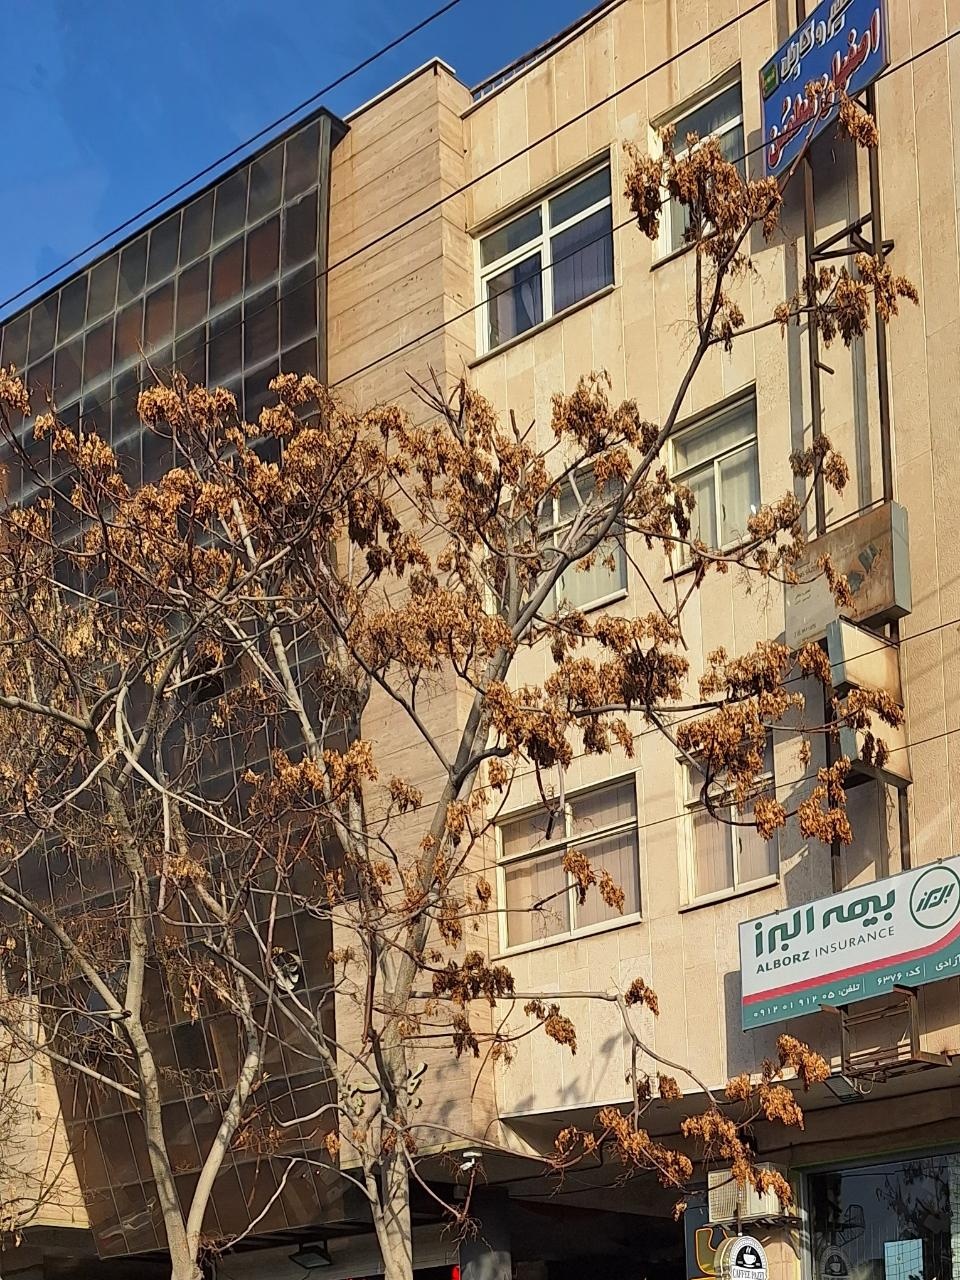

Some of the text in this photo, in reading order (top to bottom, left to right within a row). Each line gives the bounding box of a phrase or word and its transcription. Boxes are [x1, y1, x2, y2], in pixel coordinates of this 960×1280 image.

[754, 888, 896, 958] بیمه البرز
[756, 926, 895, 974] ALBORZ INSURANCE
